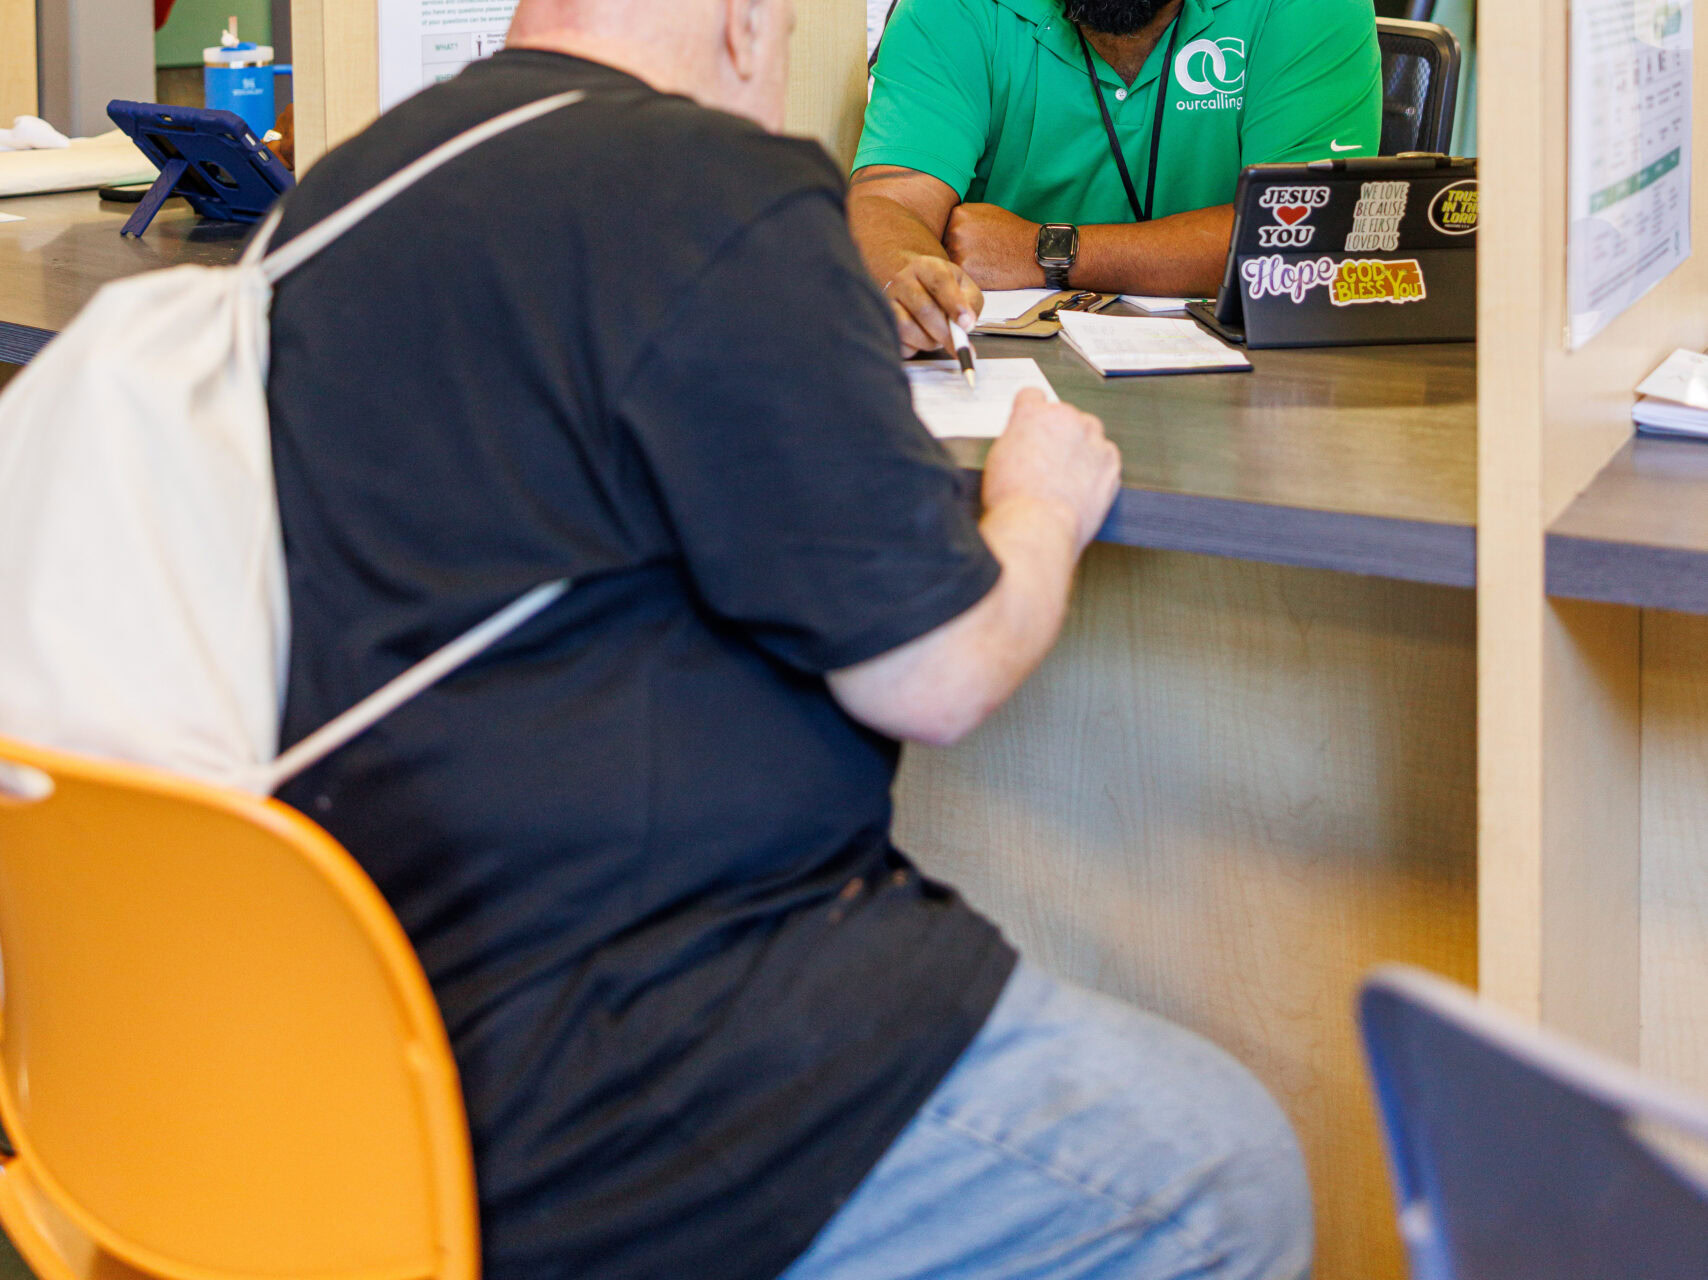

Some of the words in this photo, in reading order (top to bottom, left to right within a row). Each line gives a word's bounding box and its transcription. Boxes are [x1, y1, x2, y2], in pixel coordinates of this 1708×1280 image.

[1176, 93, 1243, 111] ourcalling
[1262, 188, 1328, 205] JESUS
[1363, 183, 1379, 199] WE
[1380, 183, 1406, 199] LOVE
[1447, 190, 1480, 202] TRUS
[1356, 200, 1404, 217] BECAUSE
[1441, 200, 1458, 213] IN
[1354, 218, 1367, 232] HE
[1369, 217, 1399, 233] FIRST
[1442, 212, 1477, 224] LORD
[1260, 227, 1312, 244] YOU
[1346, 233, 1380, 249] LOVED
[1381, 233, 1397, 249] US
[1245, 254, 1334, 299] Hope
[1341, 261, 1386, 283] GOD
[1335, 280, 1386, 302] BLESS
